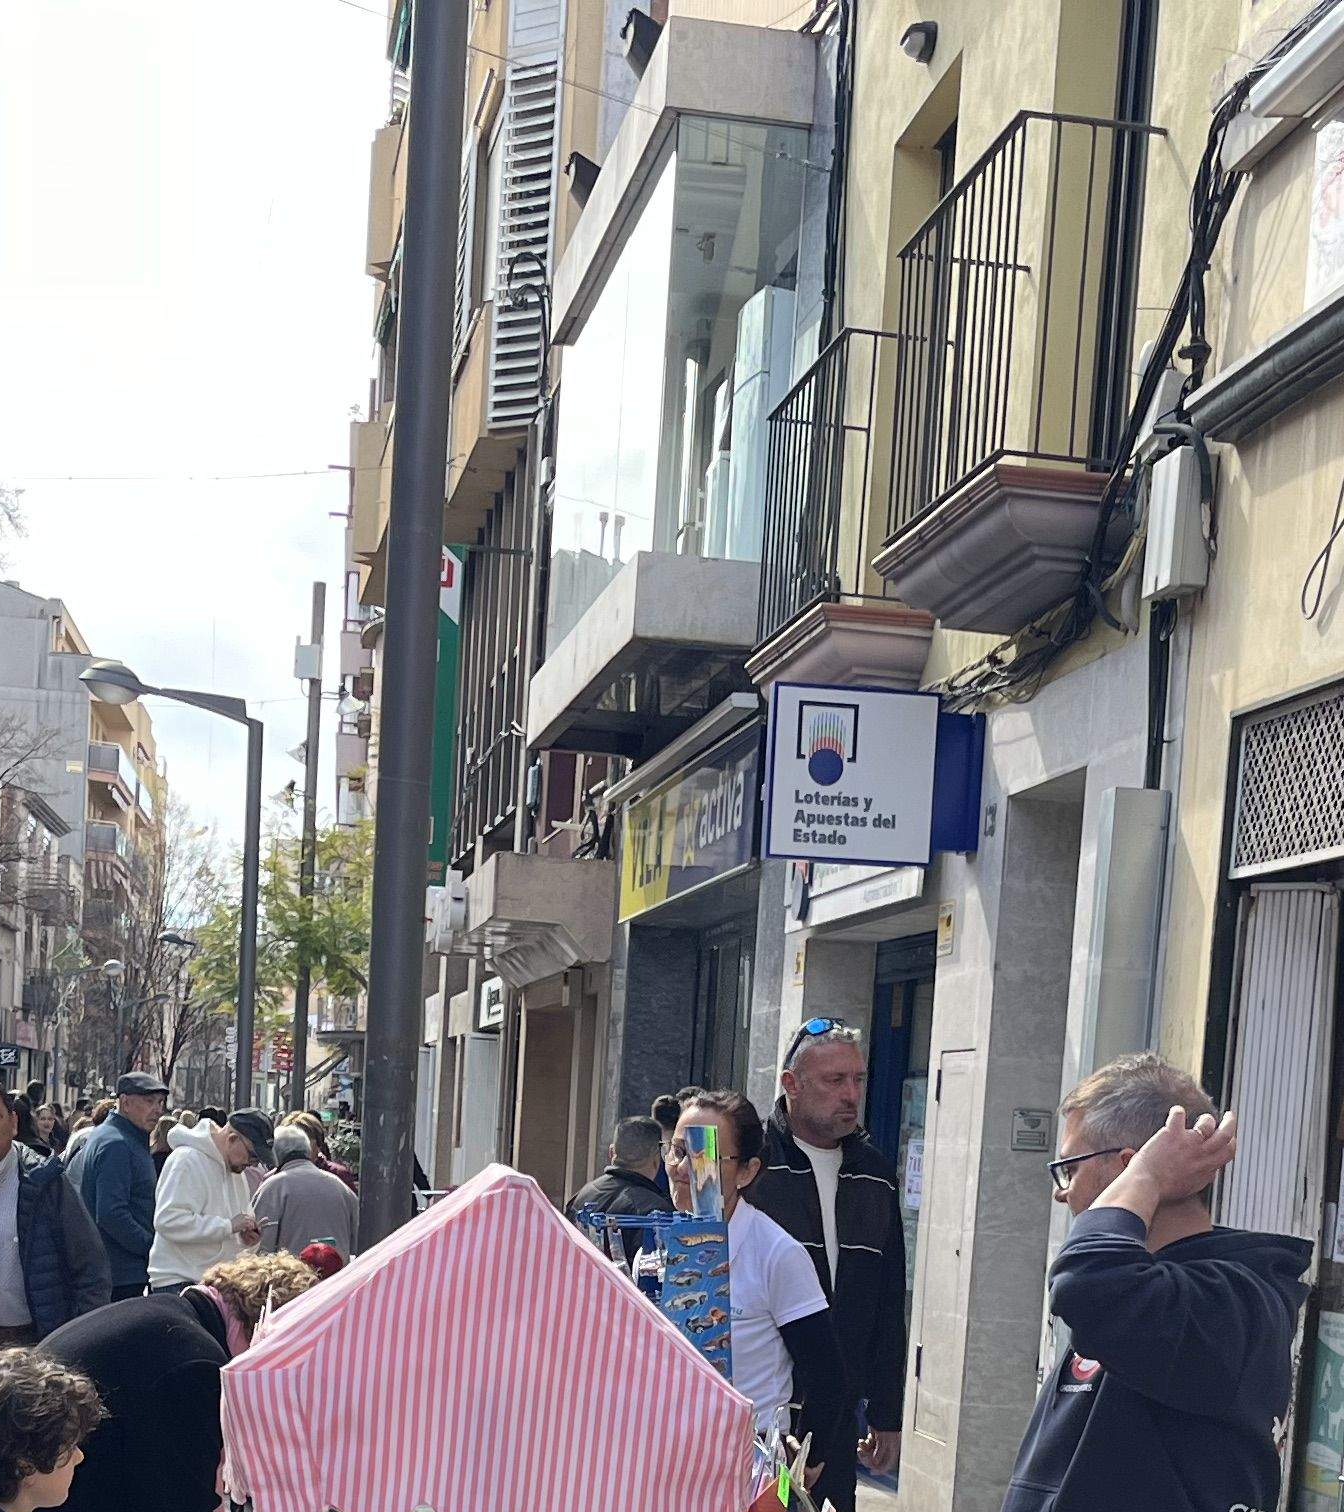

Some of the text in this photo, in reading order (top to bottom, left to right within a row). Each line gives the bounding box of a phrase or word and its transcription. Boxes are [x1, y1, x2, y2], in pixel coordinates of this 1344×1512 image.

[794, 789, 873, 812] Loterías y
[794, 809, 896, 829] Apuestas del
[793, 829, 847, 846] Estado
